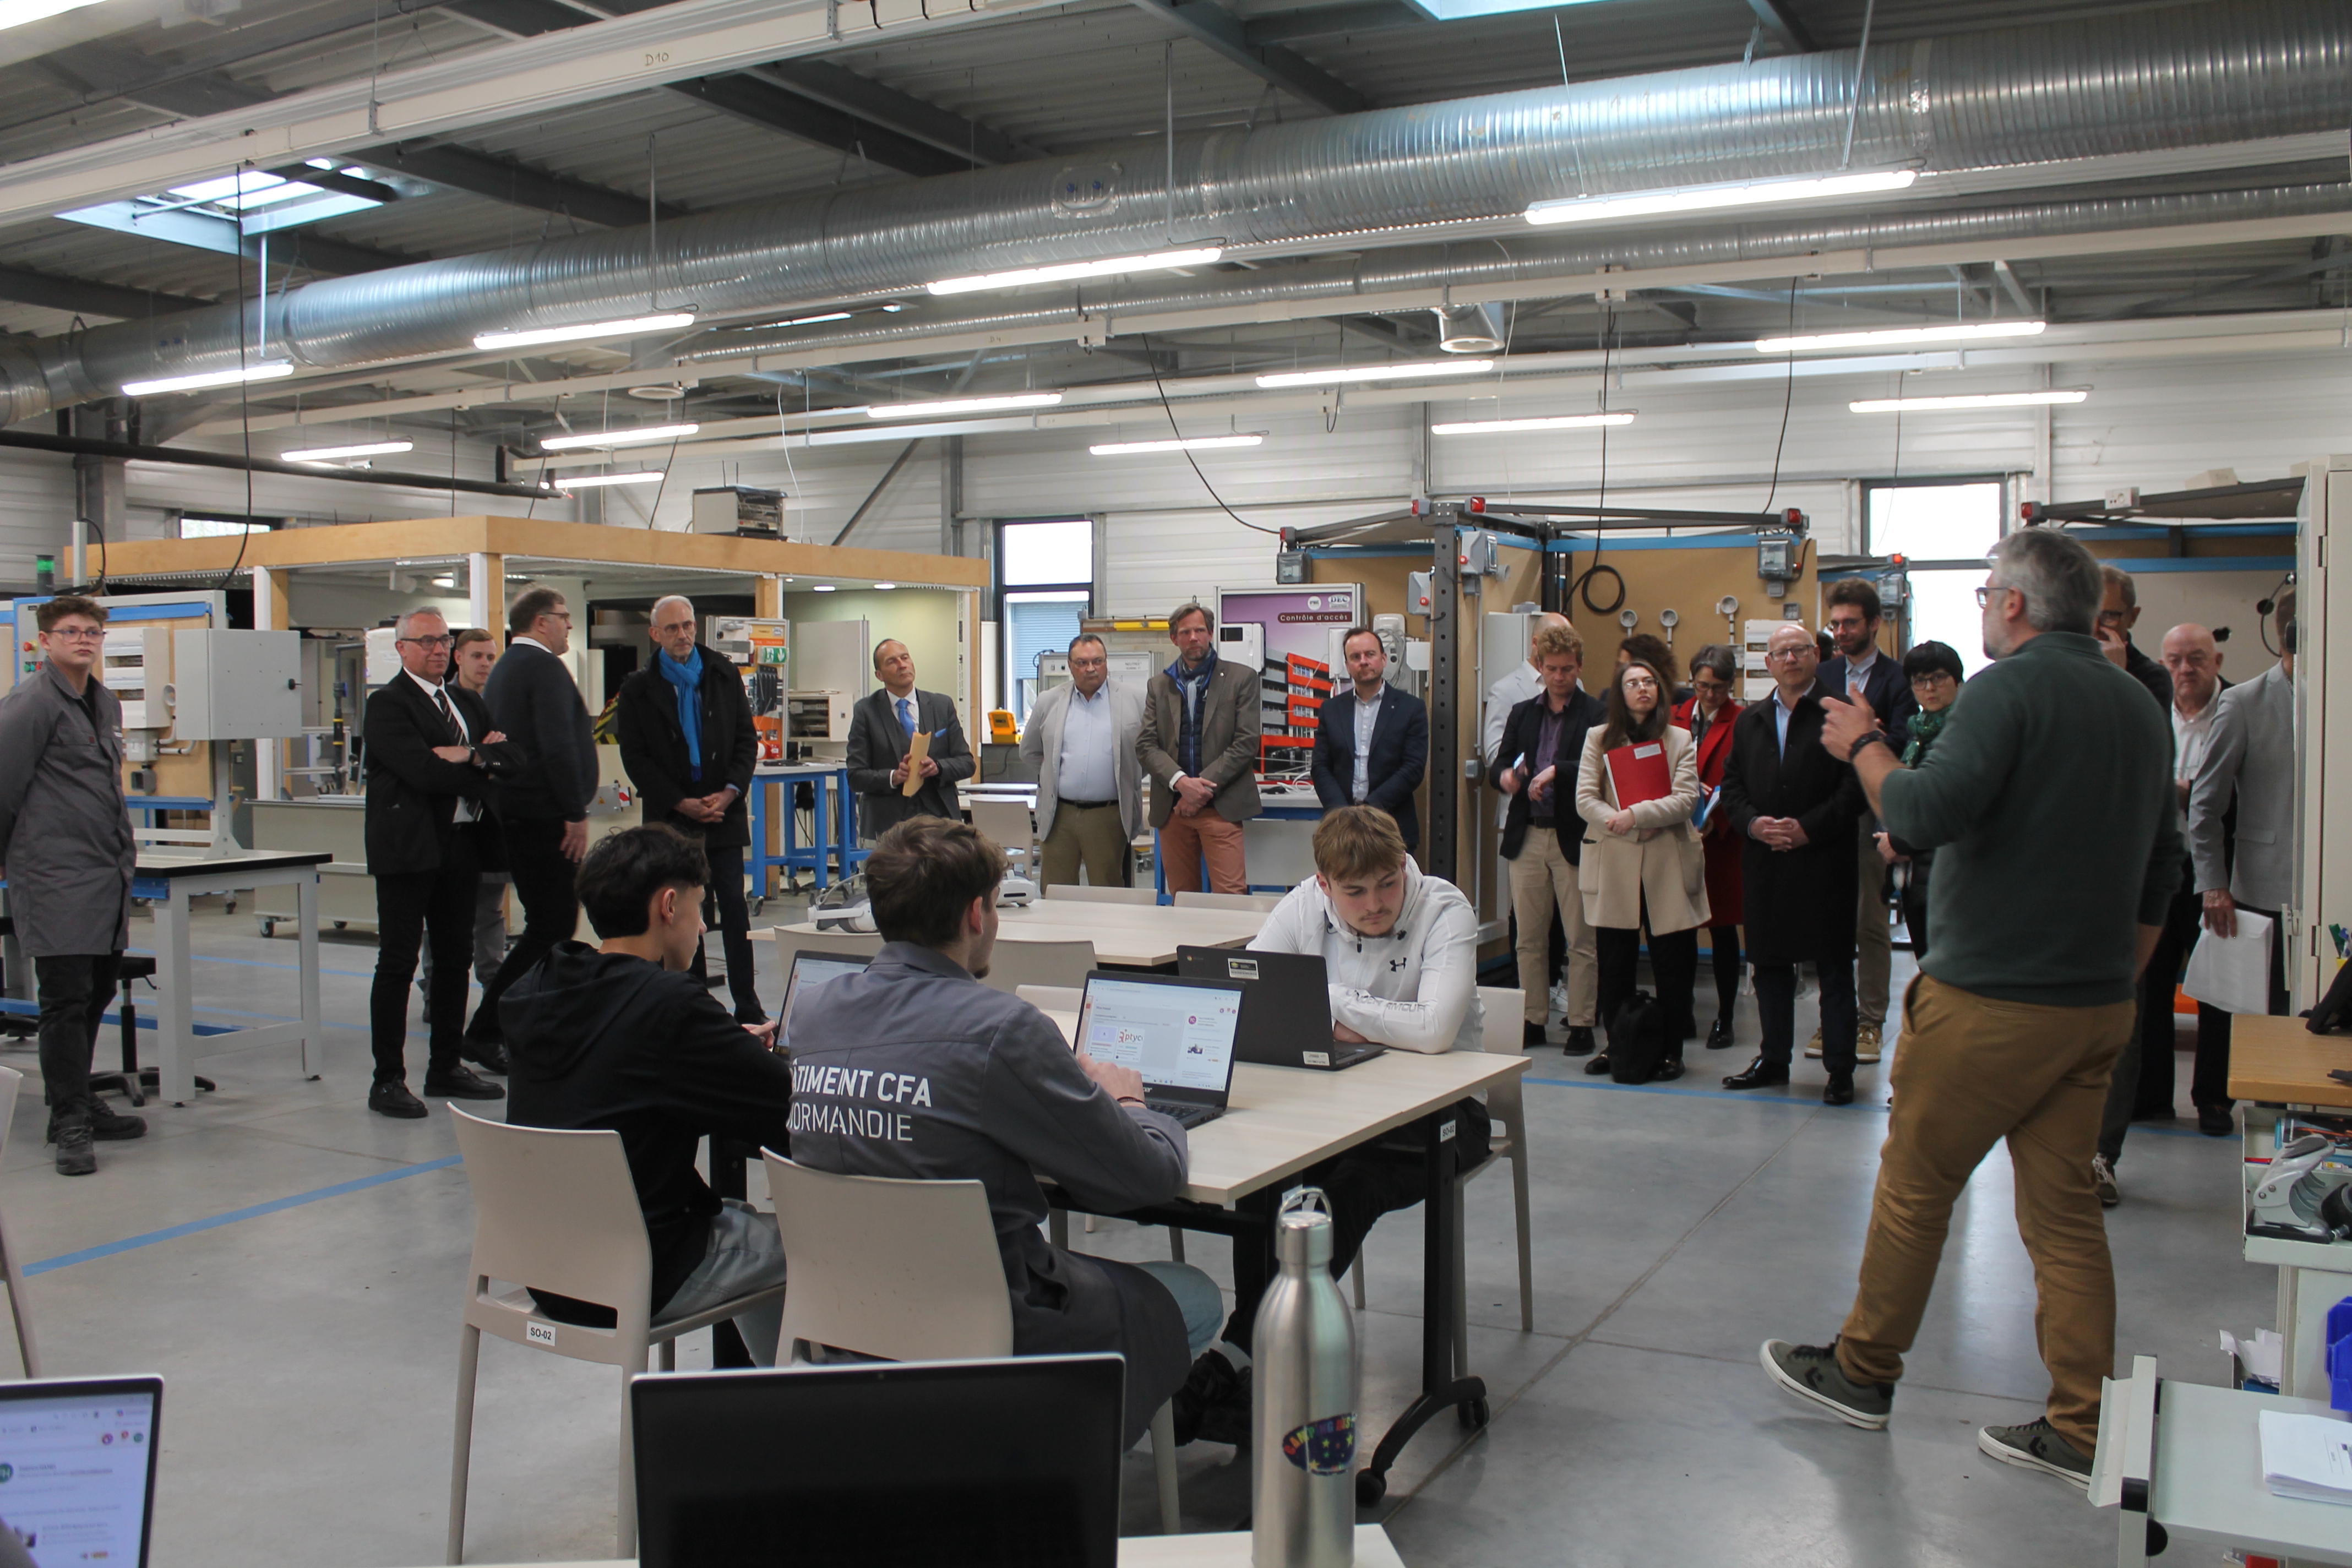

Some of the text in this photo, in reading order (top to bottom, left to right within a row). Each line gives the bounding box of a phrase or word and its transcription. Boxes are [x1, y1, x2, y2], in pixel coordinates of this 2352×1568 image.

[645, 52, 669, 66] D10
[877, 1072, 932, 1108] CFA
[531, 1327, 552, 1340] SO-02
